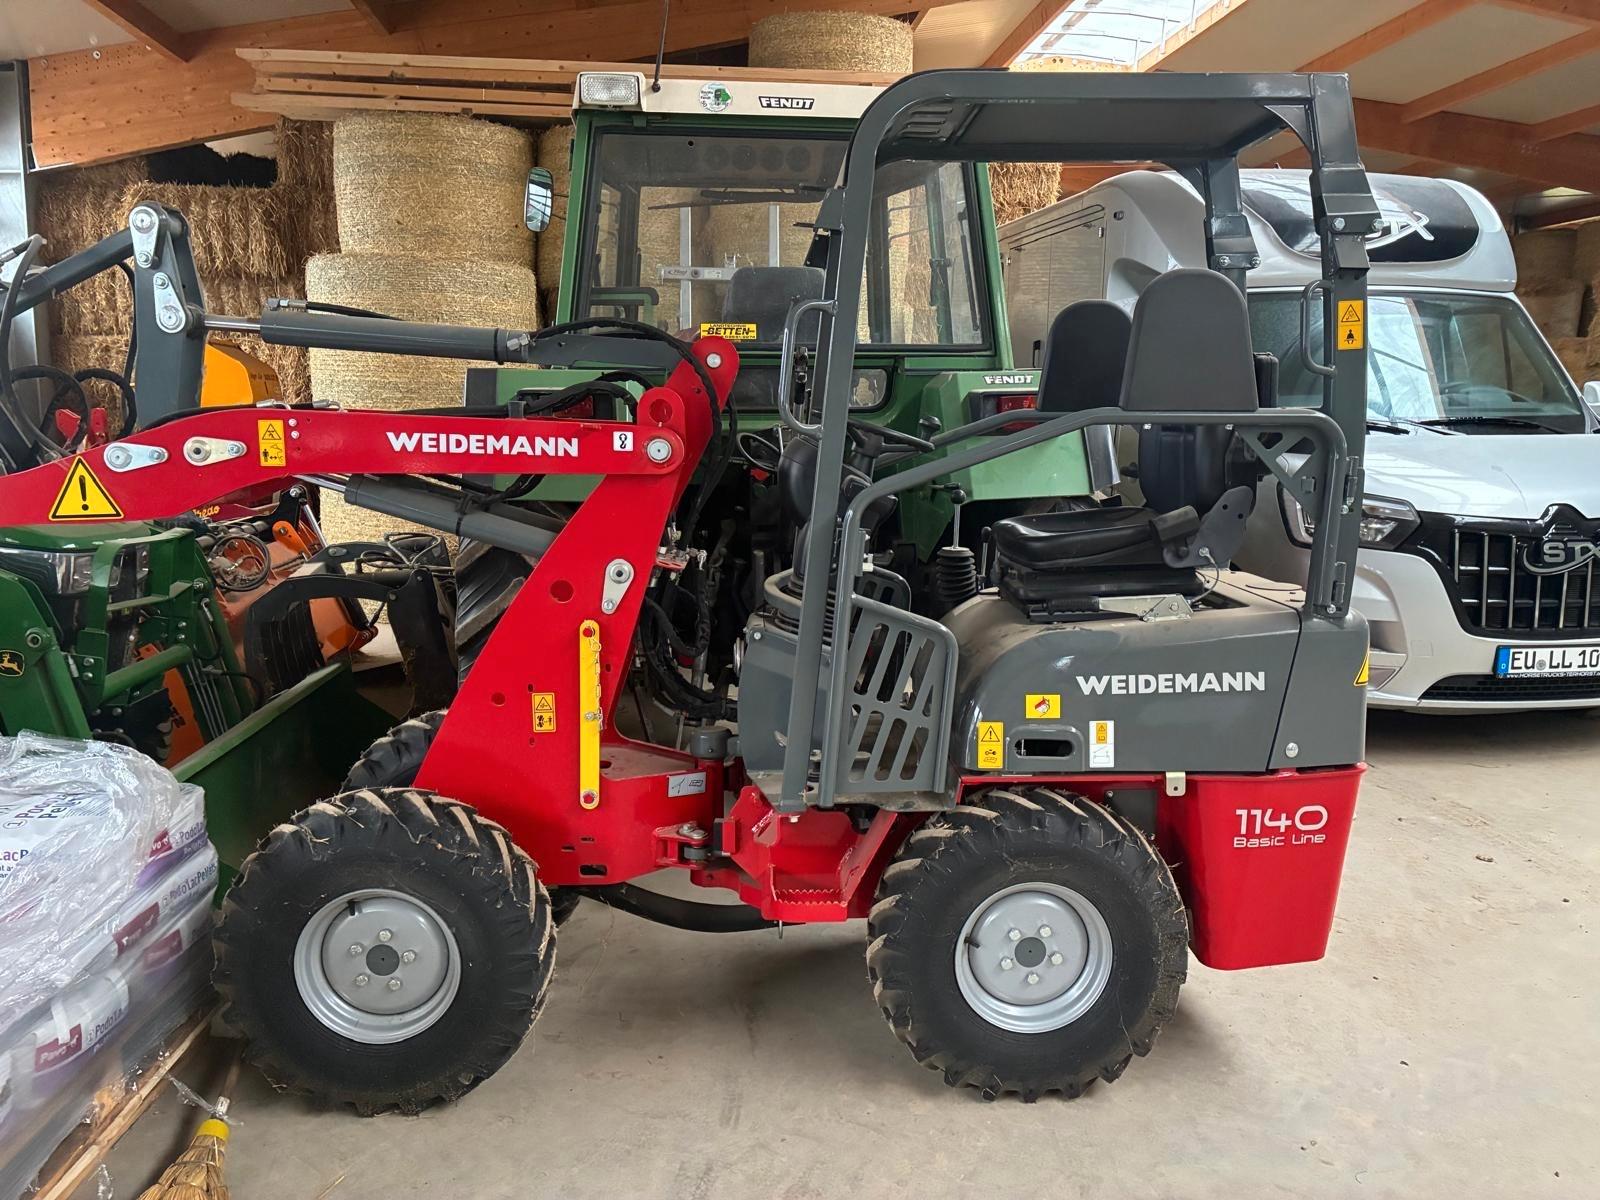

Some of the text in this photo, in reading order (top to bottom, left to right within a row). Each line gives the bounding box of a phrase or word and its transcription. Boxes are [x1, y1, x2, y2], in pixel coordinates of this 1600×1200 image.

[760, 97, 813, 109] FENDT
[707, 327, 750, 335] BETTEN
[984, 375, 1034, 384] FENDT
[386, 432, 579, 457] WEIDEMANN
[1511, 651, 1536, 670] EU
[1549, 650, 1572, 669] LL
[1076, 671, 1266, 696] WEIDEMANN
[1235, 805, 1329, 835] 1140
[1233, 833, 1326, 848] Basic Line
